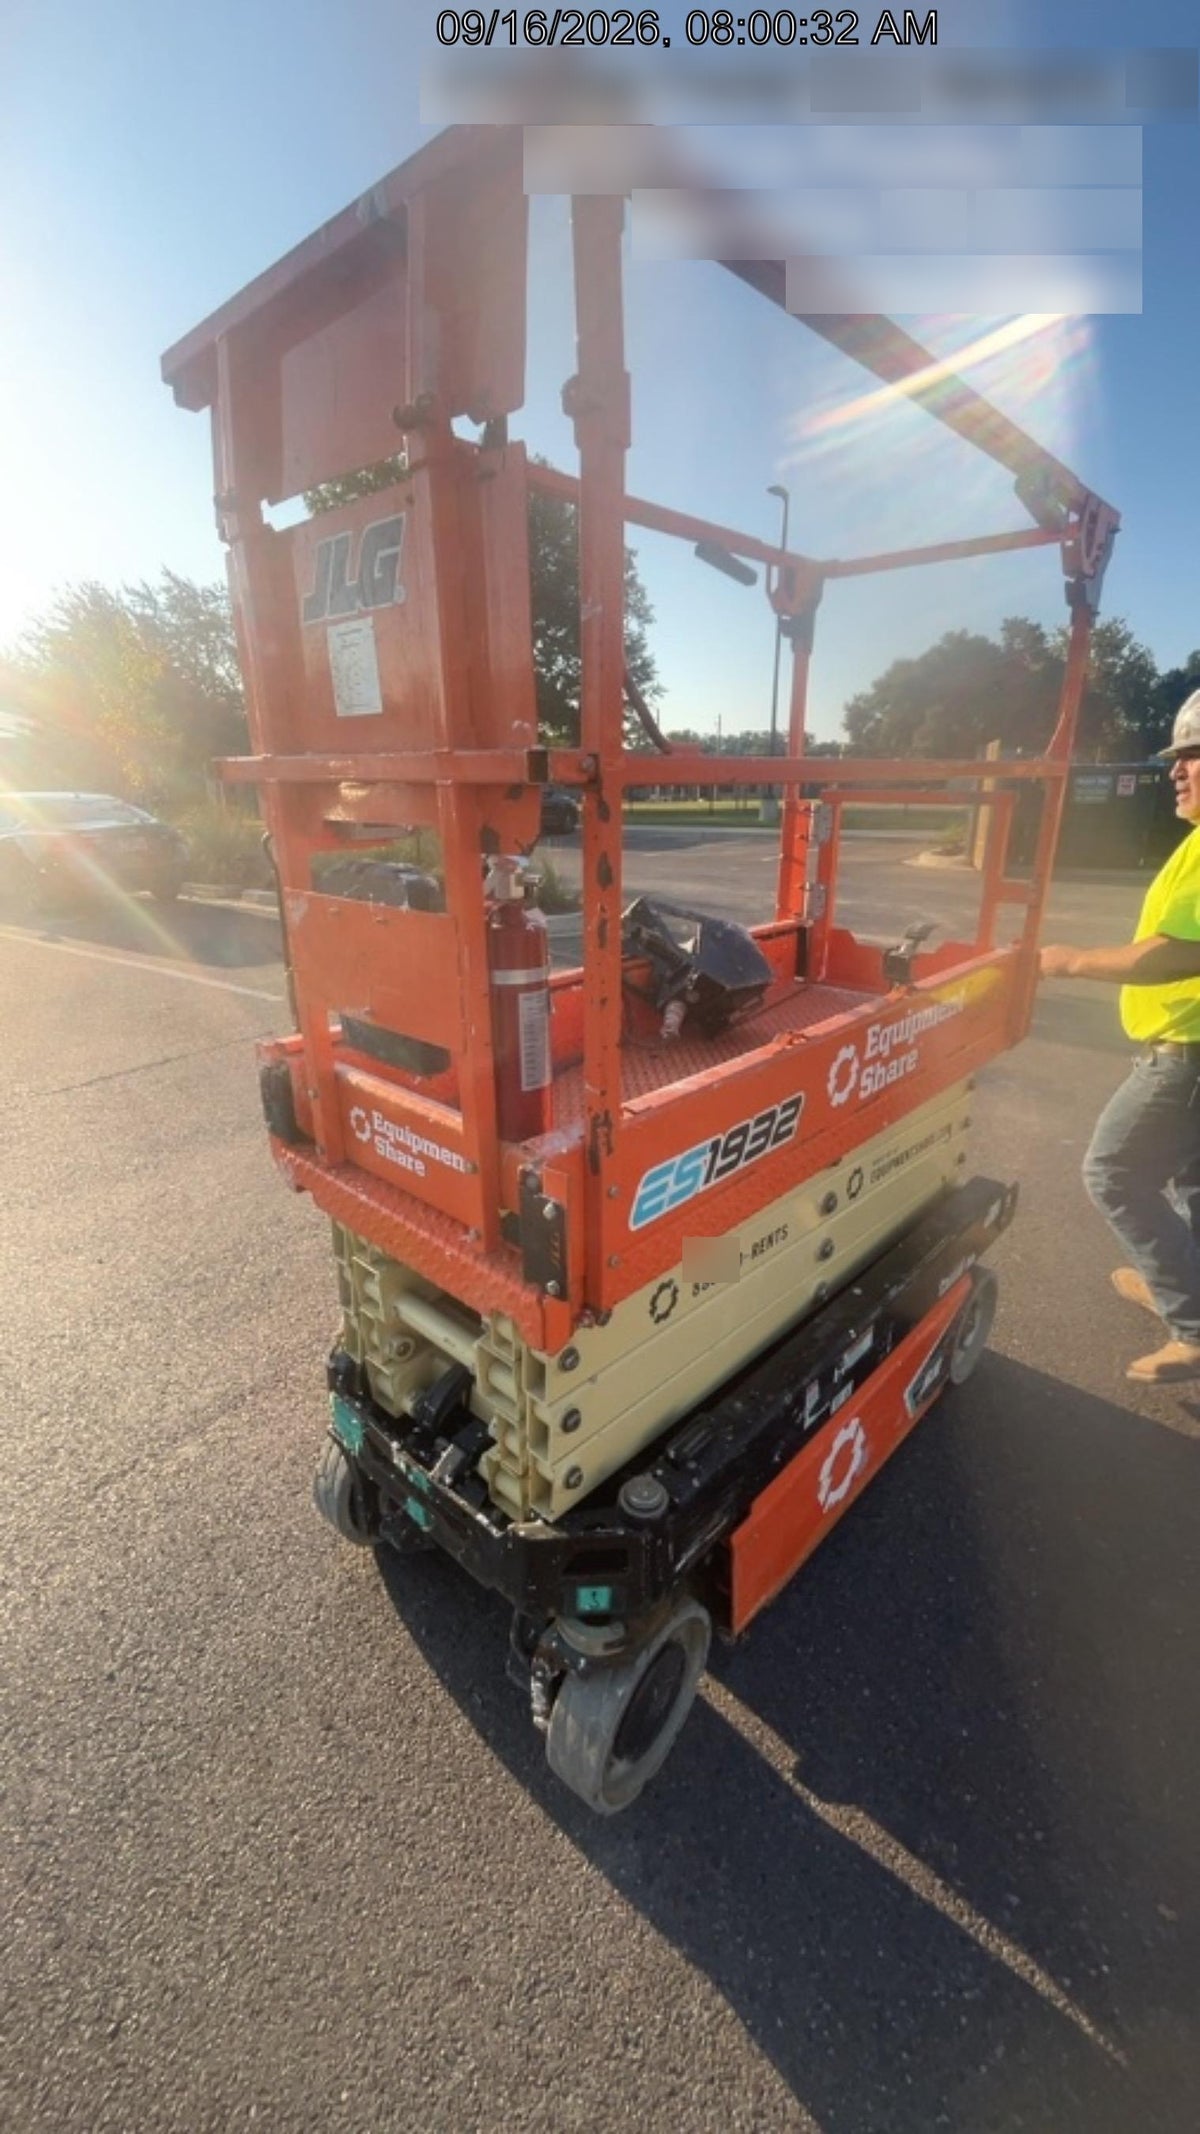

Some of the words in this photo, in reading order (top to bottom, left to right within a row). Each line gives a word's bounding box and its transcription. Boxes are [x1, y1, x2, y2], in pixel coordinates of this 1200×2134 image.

[301, 511, 407, 626] JLG
[858, 1047, 920, 1100] Share
[371, 1109, 472, 1174] Equipmen
[374, 1134, 427, 1177] Share
[629, 1092, 806, 1232] ES1932
